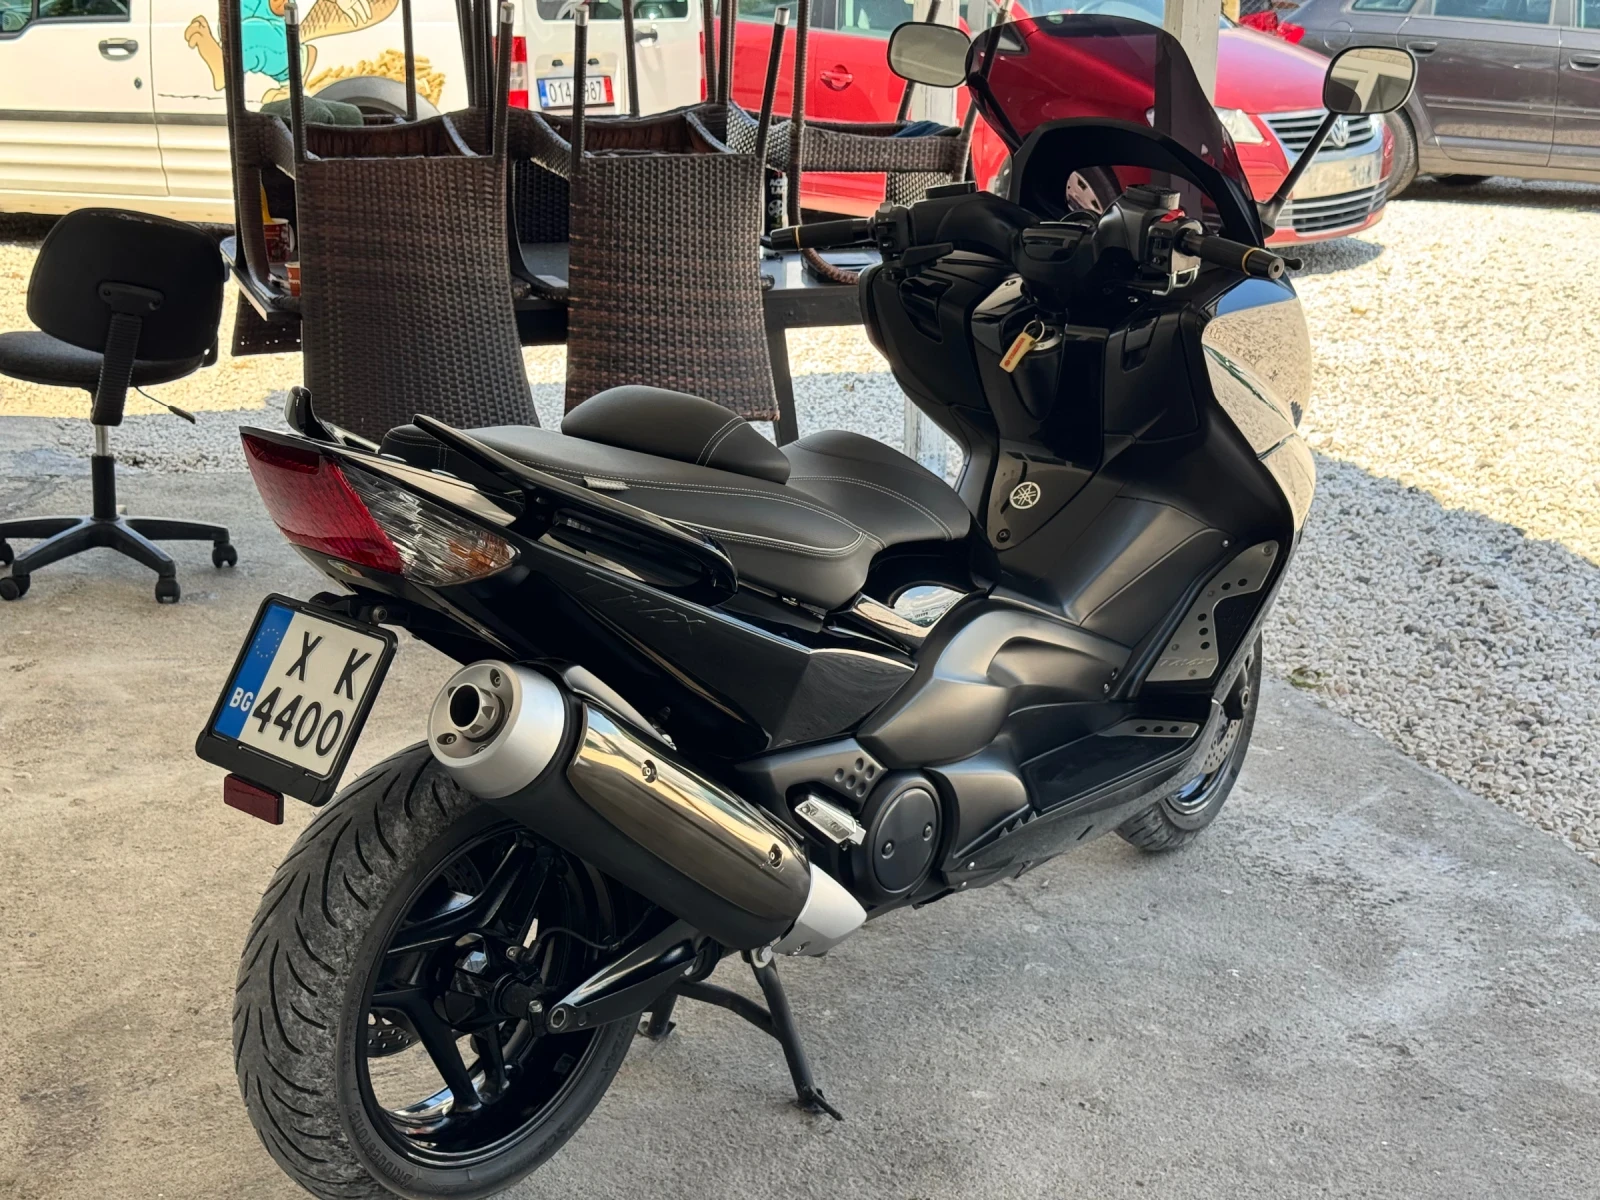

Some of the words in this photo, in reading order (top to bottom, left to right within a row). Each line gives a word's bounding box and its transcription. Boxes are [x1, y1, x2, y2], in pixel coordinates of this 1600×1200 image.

[229, 687, 254, 712] BG
[285, 631, 323, 682] X
[333, 648, 373, 701] K
[252, 686, 344, 757] 4400
